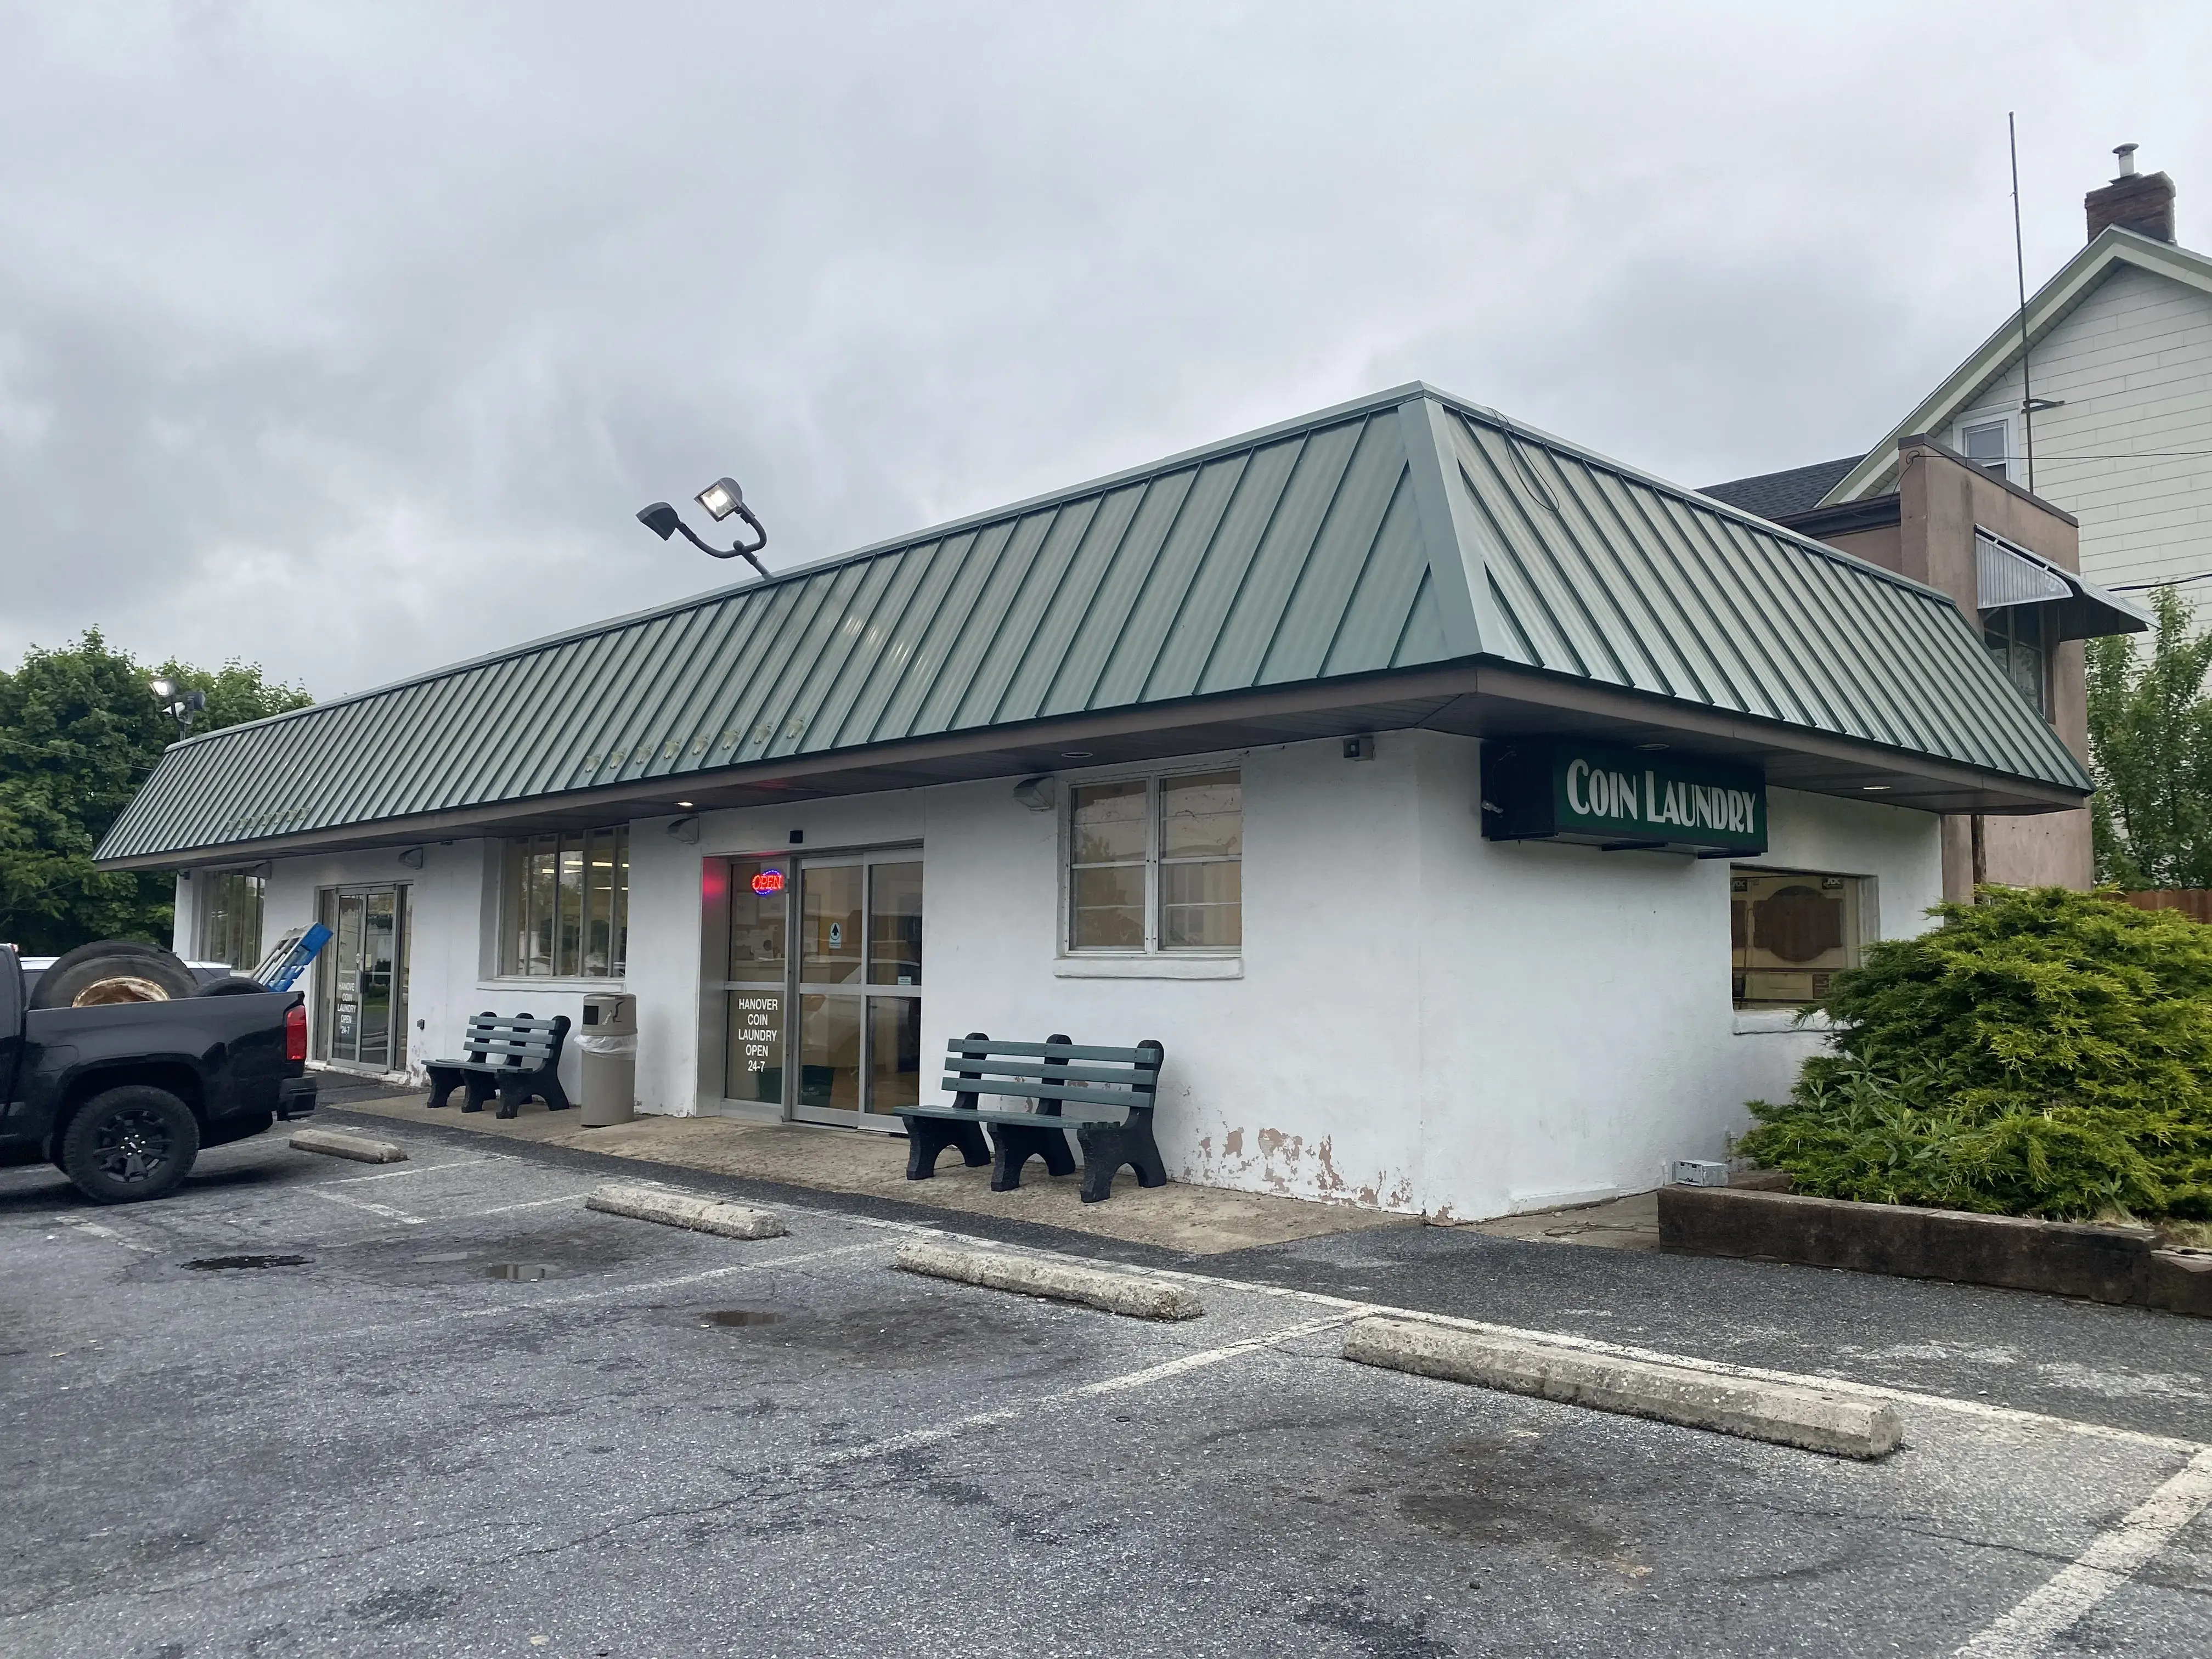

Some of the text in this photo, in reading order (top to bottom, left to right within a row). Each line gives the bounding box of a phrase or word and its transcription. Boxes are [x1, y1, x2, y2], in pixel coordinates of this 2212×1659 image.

[752, 874, 783, 890] OPEN
[338, 982, 356, 991] HANOVE
[342, 993, 353, 1002] COIN
[337, 1003, 357, 1013] LAUNDRY
[738, 998, 778, 1011] HANOVER
[340, 1014, 352, 1024] OPEN
[747, 1014, 768, 1026] COIN
[341, 1025, 350, 1035] 24-7
[738, 1029, 777, 1042] LAUNDRY
[746, 1044, 768, 1057] OPEN
[748, 1060, 765, 1072] 24-7
